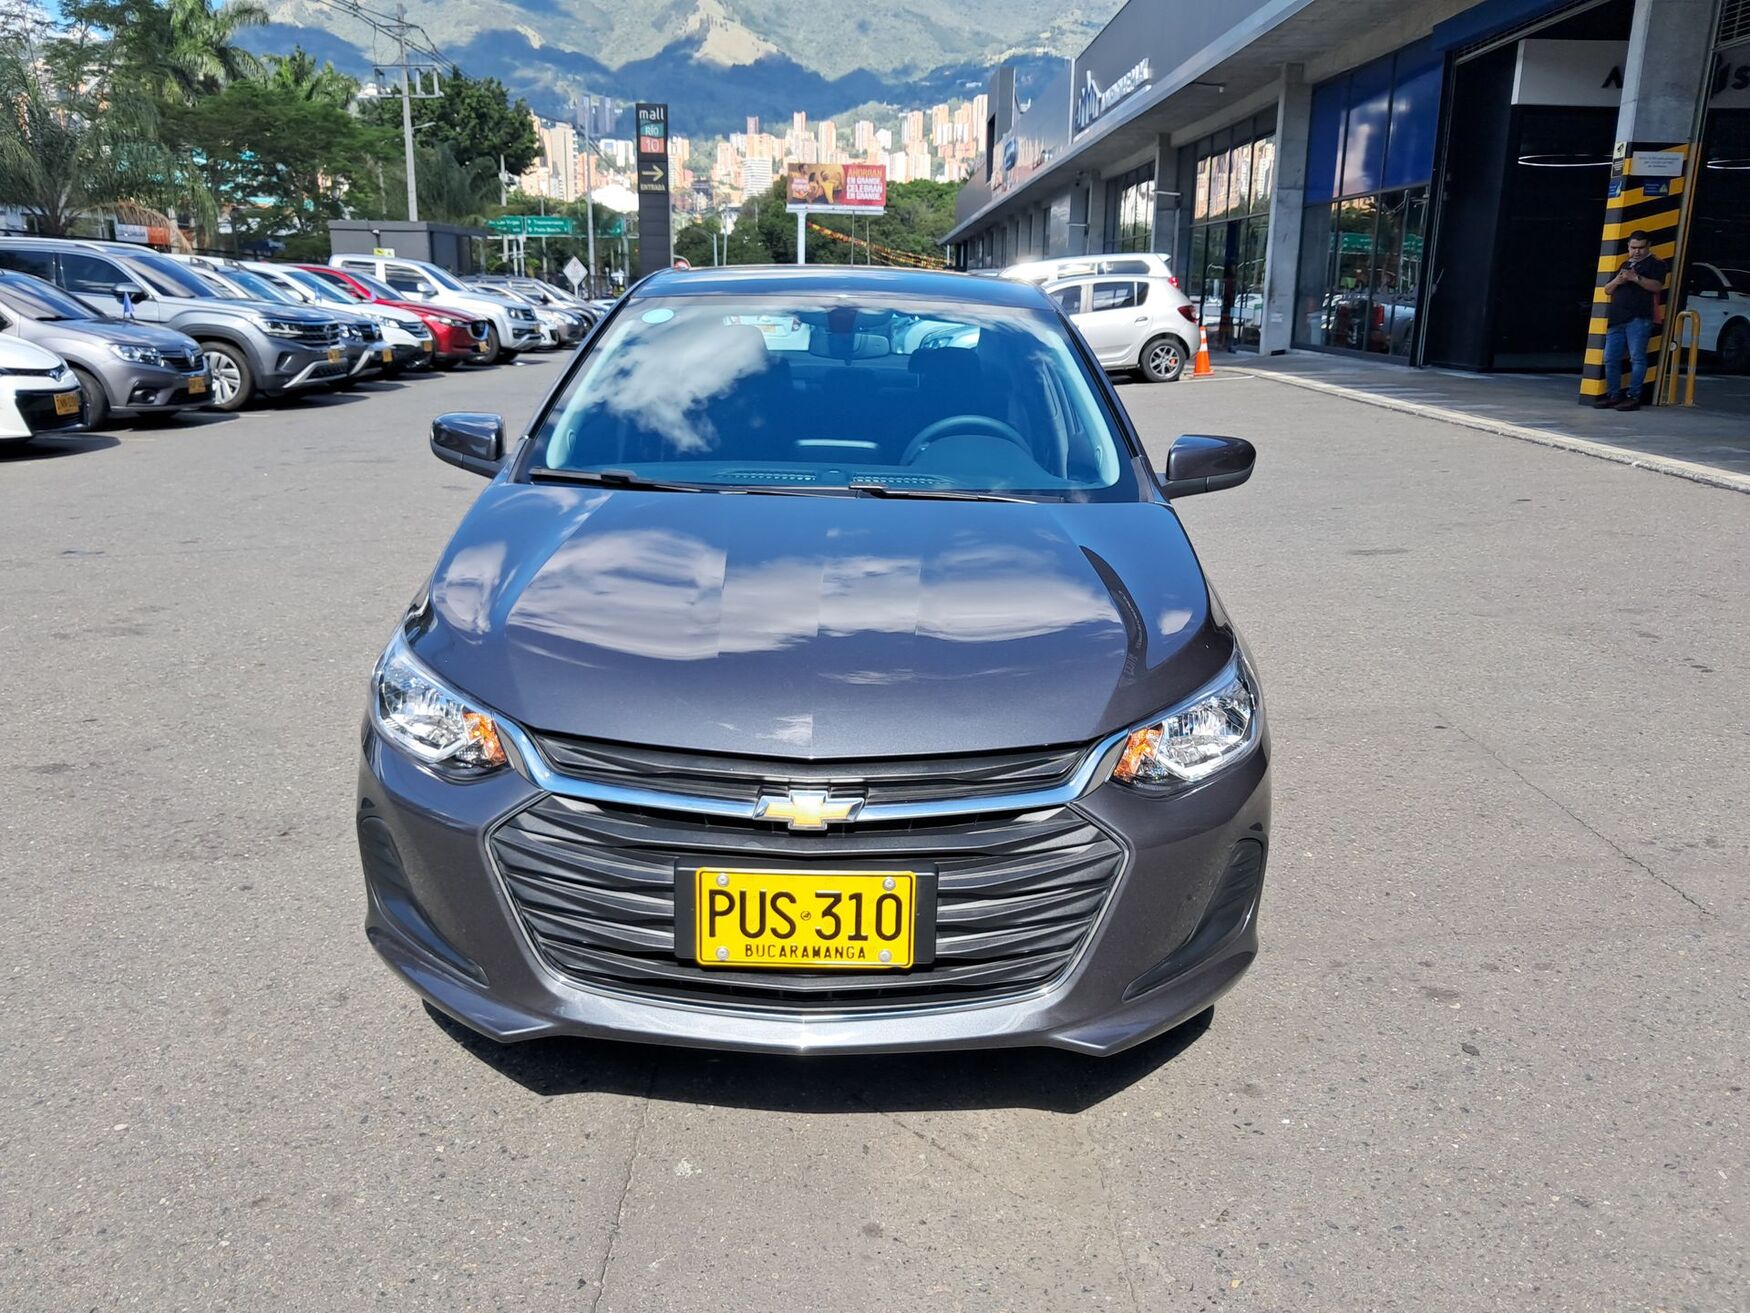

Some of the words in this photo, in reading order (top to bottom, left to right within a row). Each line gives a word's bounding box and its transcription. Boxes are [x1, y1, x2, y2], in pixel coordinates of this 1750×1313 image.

[639, 107, 664, 120] mall
[646, 140, 659, 152] 10
[640, 183, 666, 191] ENTRADA
[709, 889, 796, 939] PUS
[815, 892, 902, 942] 310
[745, 944, 866, 959] BUCARAMANGA
